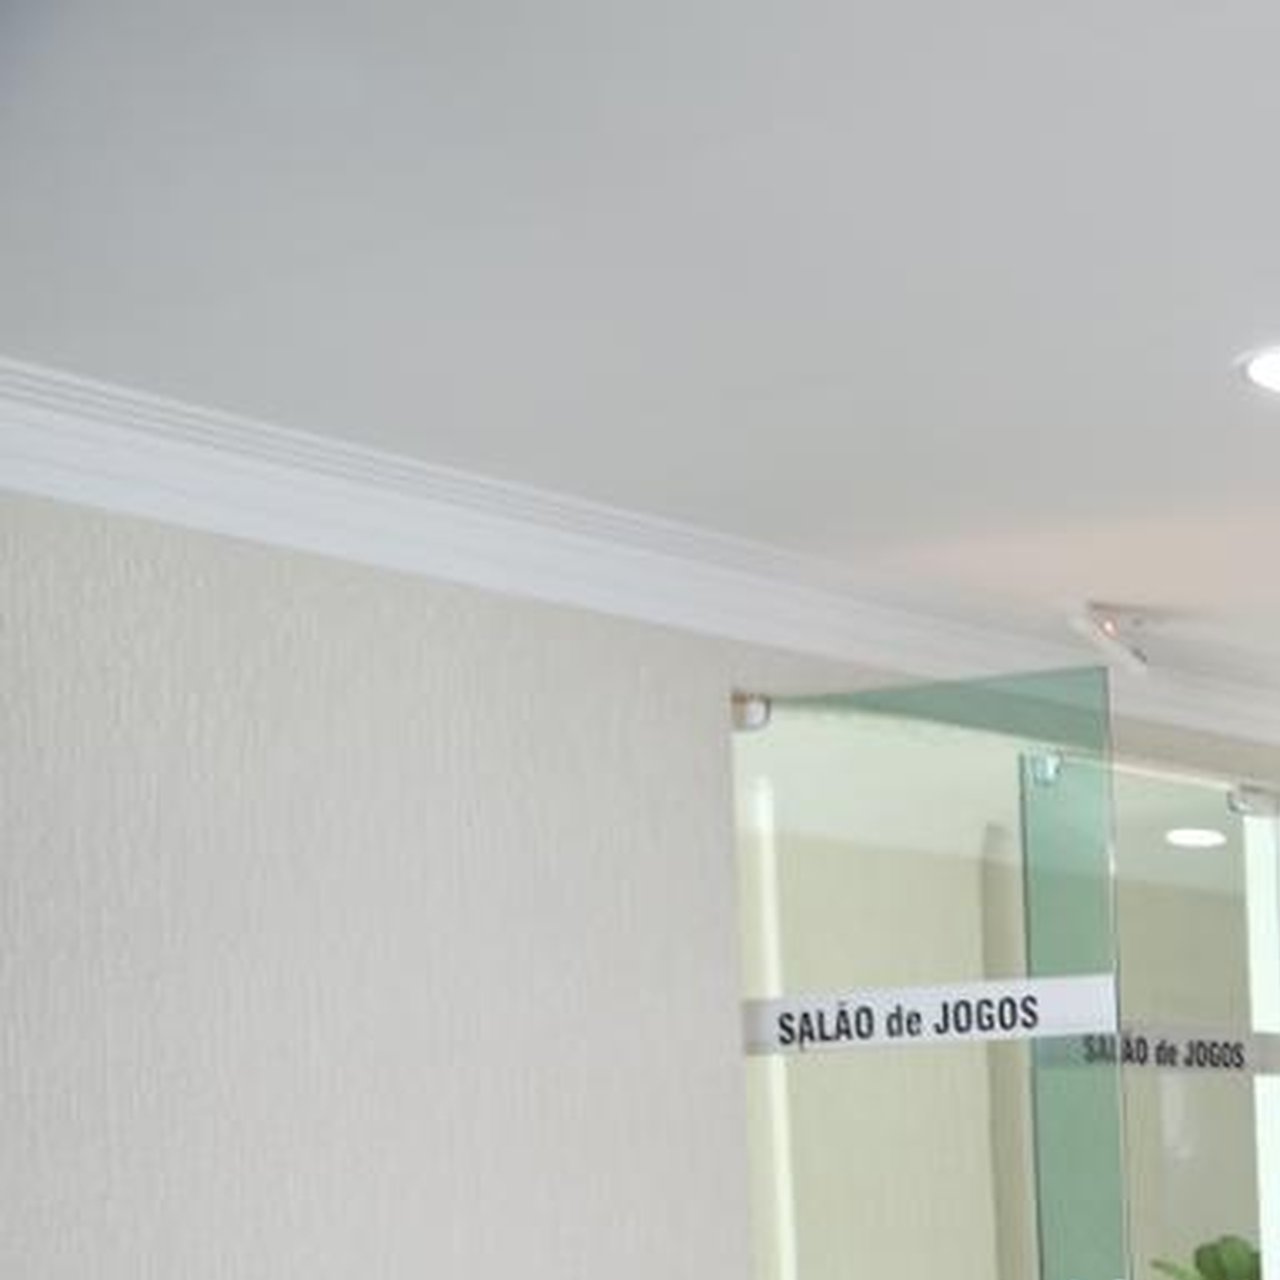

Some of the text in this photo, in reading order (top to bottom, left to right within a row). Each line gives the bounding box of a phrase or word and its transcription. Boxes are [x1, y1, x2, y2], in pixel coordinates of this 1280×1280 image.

[778, 995, 1039, 1047] SALÃO de JOGOS
[1183, 1039, 1245, 1069] JOGOS
